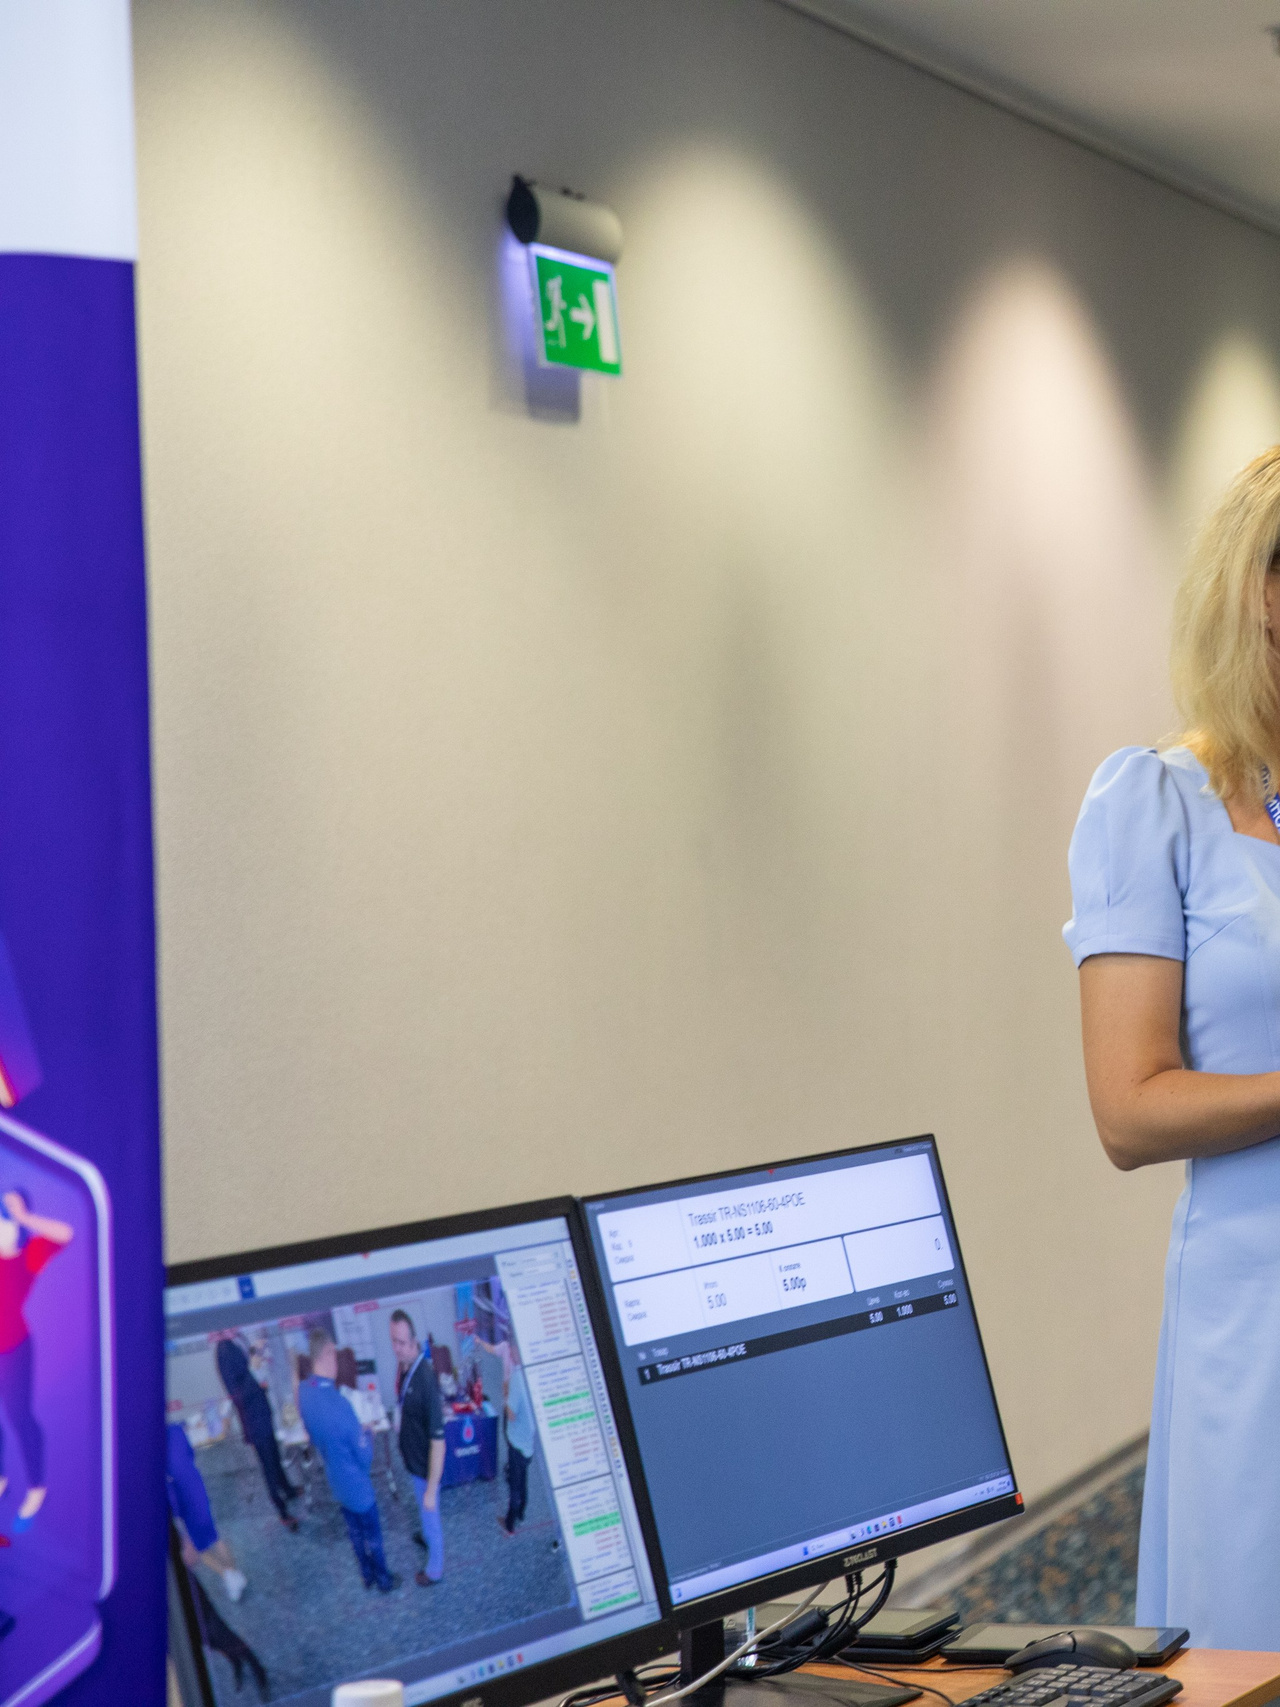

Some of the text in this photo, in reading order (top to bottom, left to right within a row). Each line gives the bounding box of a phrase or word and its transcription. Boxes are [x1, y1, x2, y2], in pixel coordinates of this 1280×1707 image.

[693, 1232, 718, 1249] 1.000
[727, 1226, 745, 1242] 5.00
[755, 1221, 773, 1237] 5.00
[707, 1293, 727, 1310] 5.00
